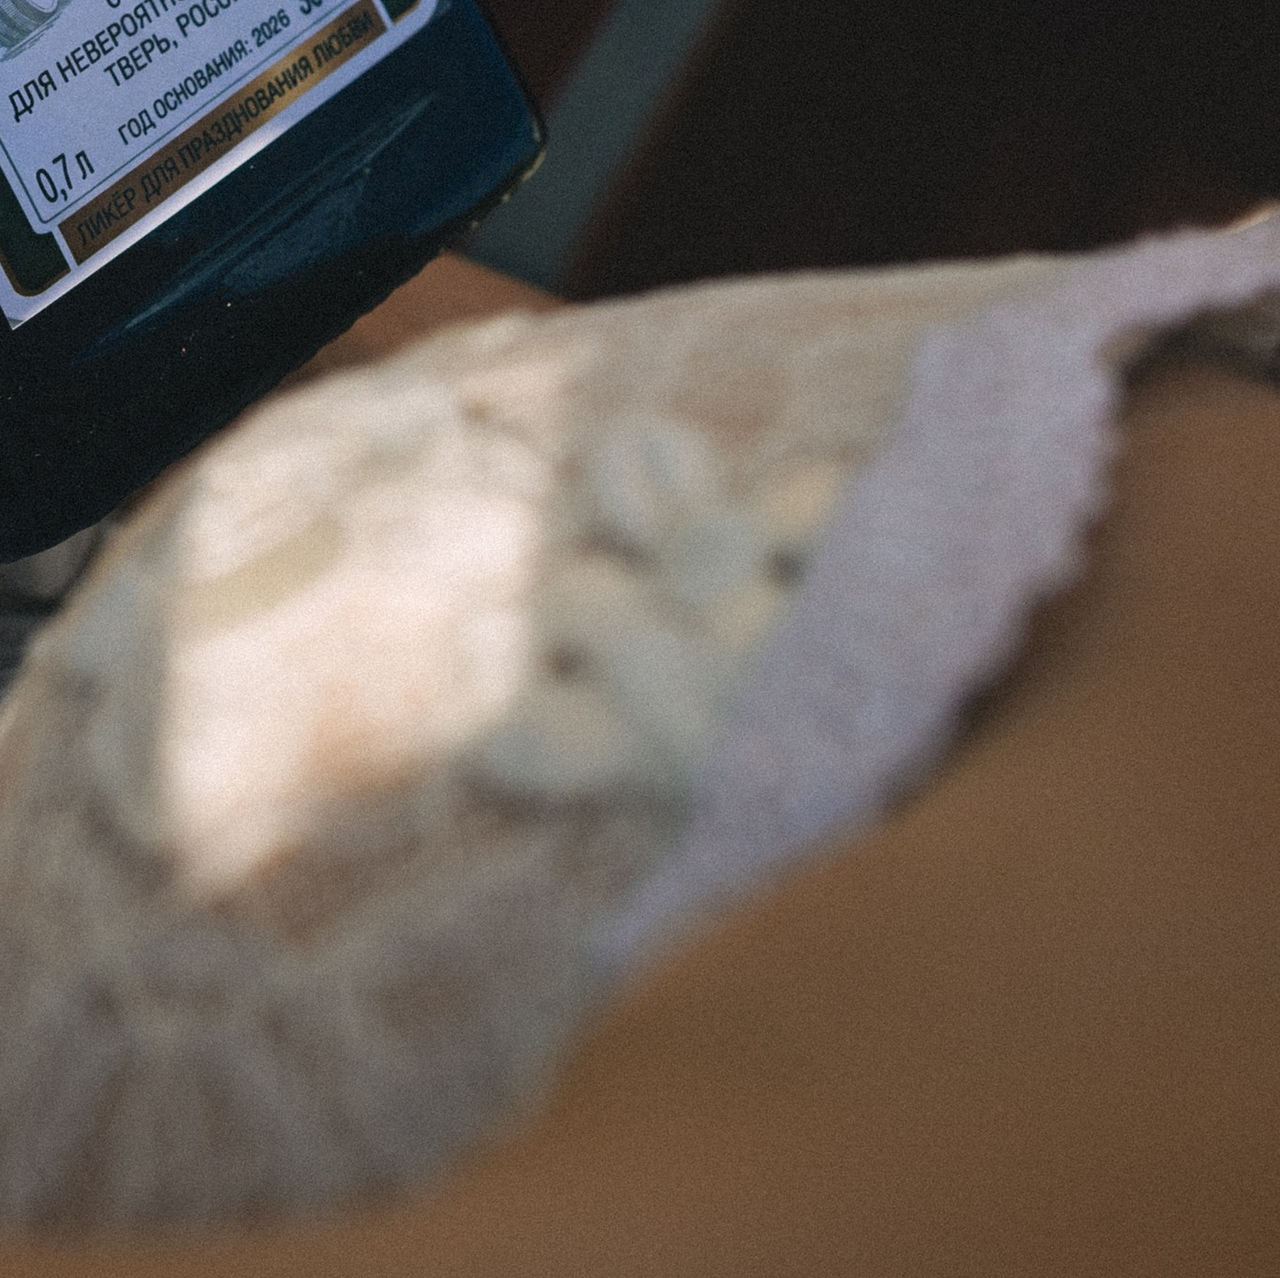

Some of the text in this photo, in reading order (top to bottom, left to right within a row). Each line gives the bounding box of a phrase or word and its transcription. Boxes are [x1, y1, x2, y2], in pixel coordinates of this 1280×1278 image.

[8, 70, 57, 122] ДЛЯ
[104, 30, 179, 86] ТВЕРЬ,
[118, 9, 290, 146] ГОД ОСНОВАНИЯ: 2026
[77, 12, 373, 245] ЛИКЁР ДЛЯ ПРАЗДНОВАНИЯ ЛЮБВИ
